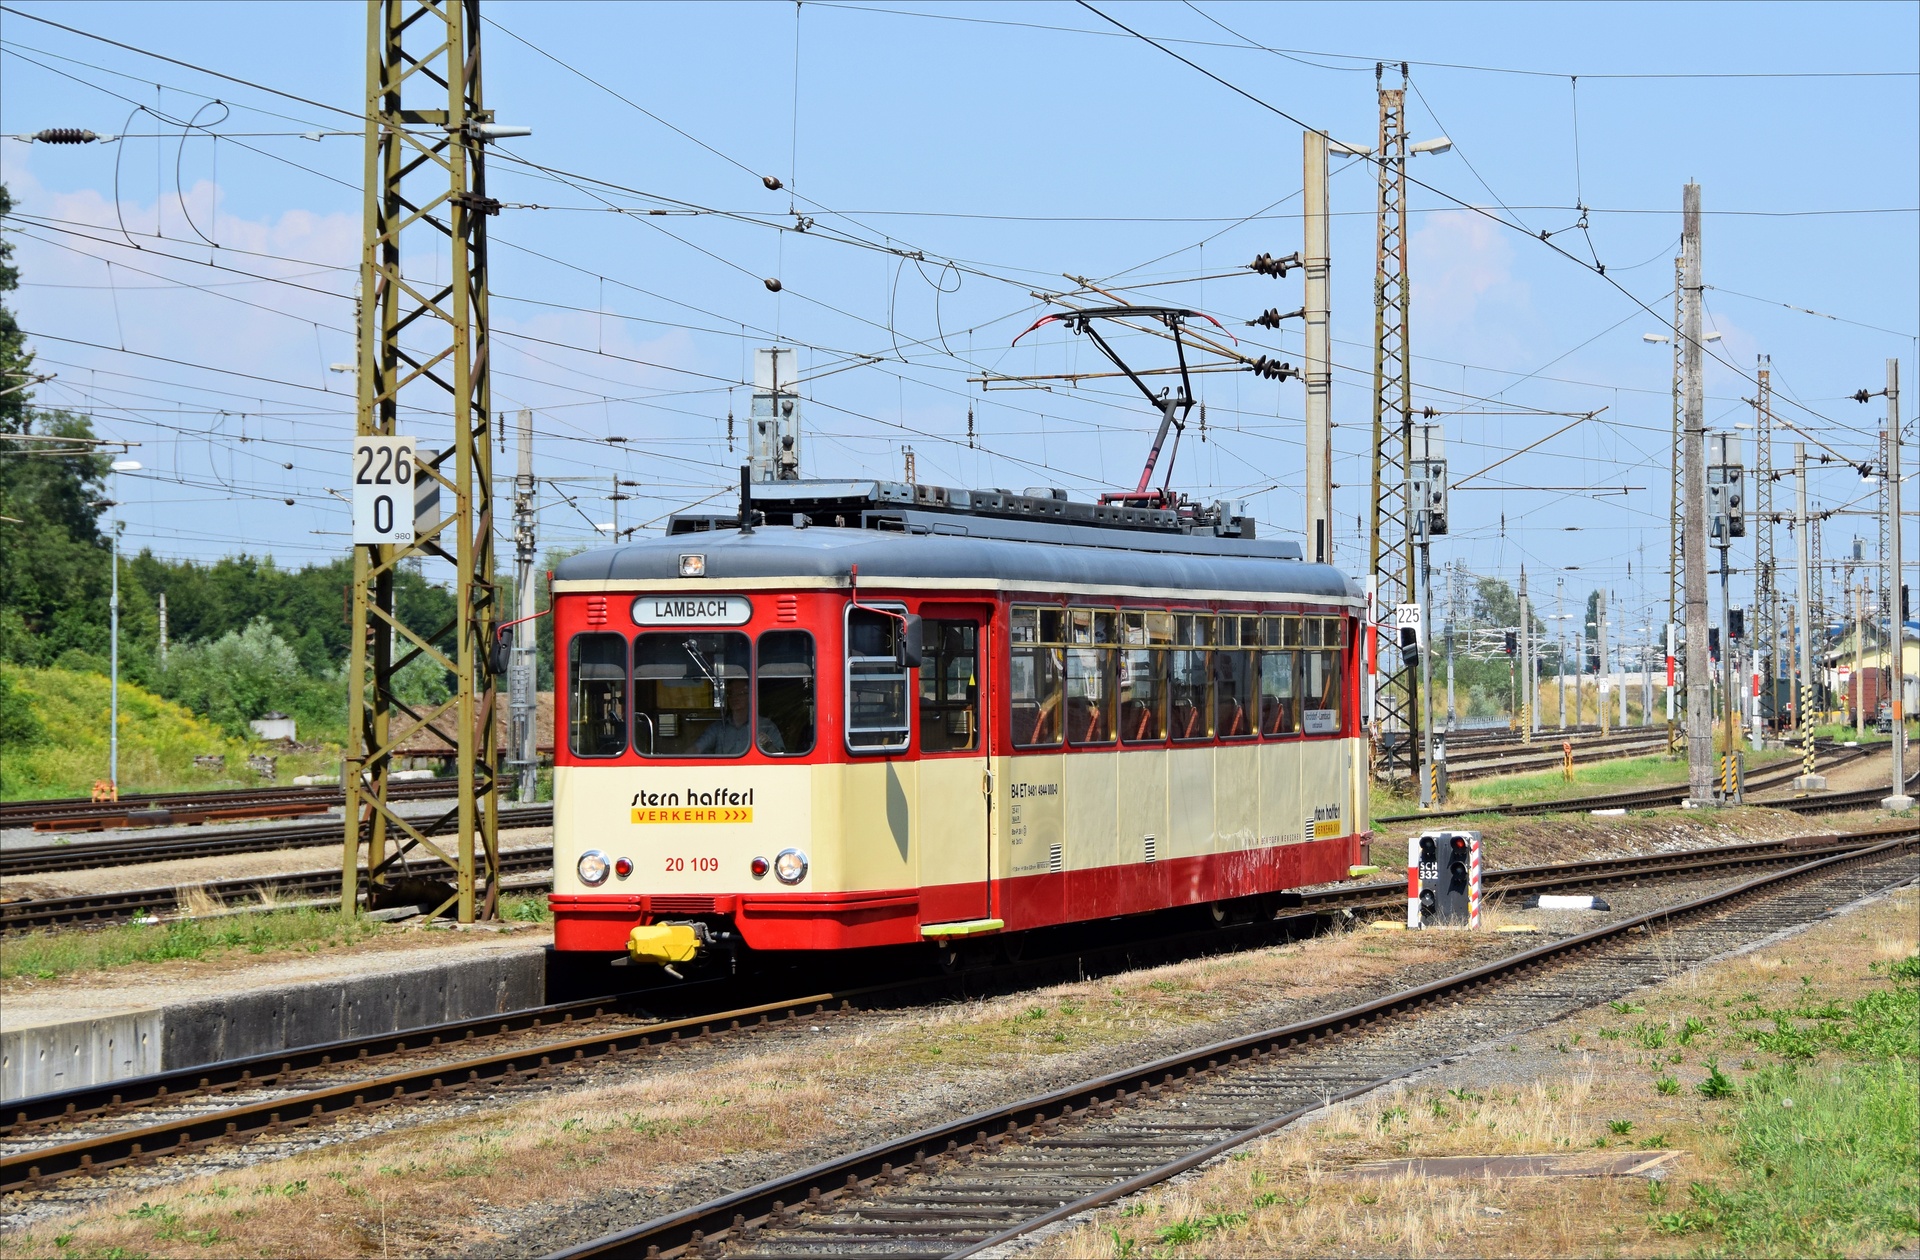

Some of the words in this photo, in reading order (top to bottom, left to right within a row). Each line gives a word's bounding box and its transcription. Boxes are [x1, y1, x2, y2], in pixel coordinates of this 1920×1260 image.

[356, 445, 412, 485] 226
[373, 494, 394, 534] 0
[394, 532, 411, 541] 980
[654, 600, 728, 618] LAMBACH
[1398, 607, 1420, 624] 225
[631, 789, 679, 807] stern
[687, 787, 754, 806] hafferl
[1011, 784, 1019, 798] B4
[1019, 783, 1027, 798] ET
[637, 810, 717, 822] VERKEHR
[665, 857, 684, 872] 20
[690, 857, 719, 872] 109
[1419, 861, 1438, 870] SCH
[1419, 871, 1439, 880] 332
